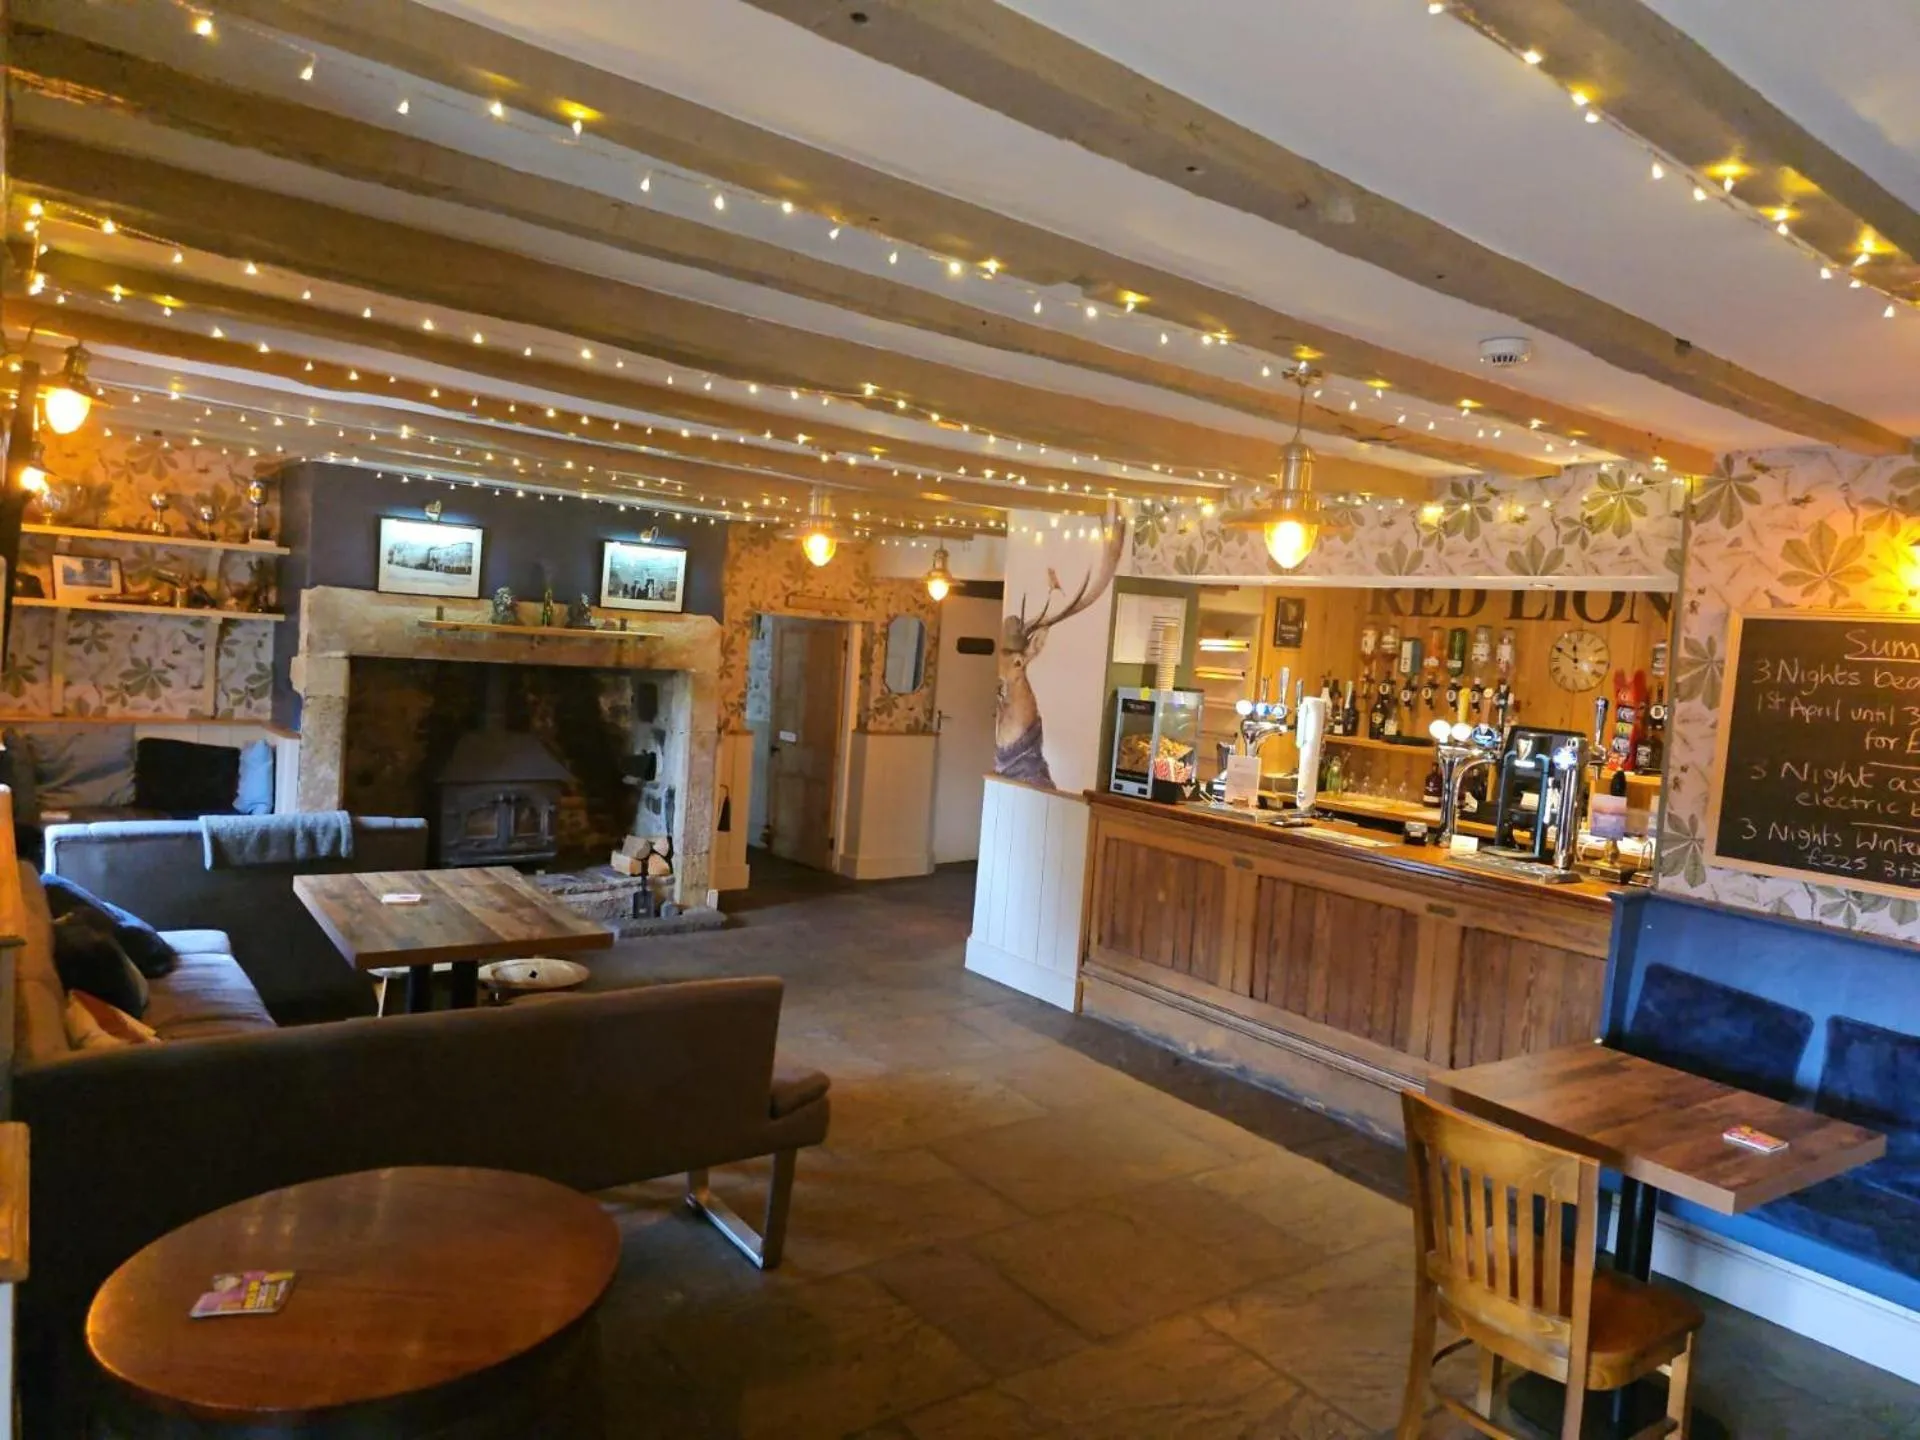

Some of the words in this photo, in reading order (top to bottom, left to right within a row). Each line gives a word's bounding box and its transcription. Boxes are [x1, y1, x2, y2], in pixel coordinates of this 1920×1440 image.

[1368, 588, 1487, 618] RED
[1506, 589, 1673, 623] LION
[1845, 628, 1920, 658] Sum
[1752, 659, 1771, 684] 3
[1776, 657, 1861, 696] Nights
[1790, 695, 1841, 723] April
[1851, 705, 1895, 727] until
[1864, 728, 1900, 751] for
[1780, 761, 1875, 793] Night
[1795, 791, 1900, 815] electric
[1740, 817, 1757, 840] 3
[1768, 821, 1842, 848] Nights
[1806, 848, 1868, 870] £225
